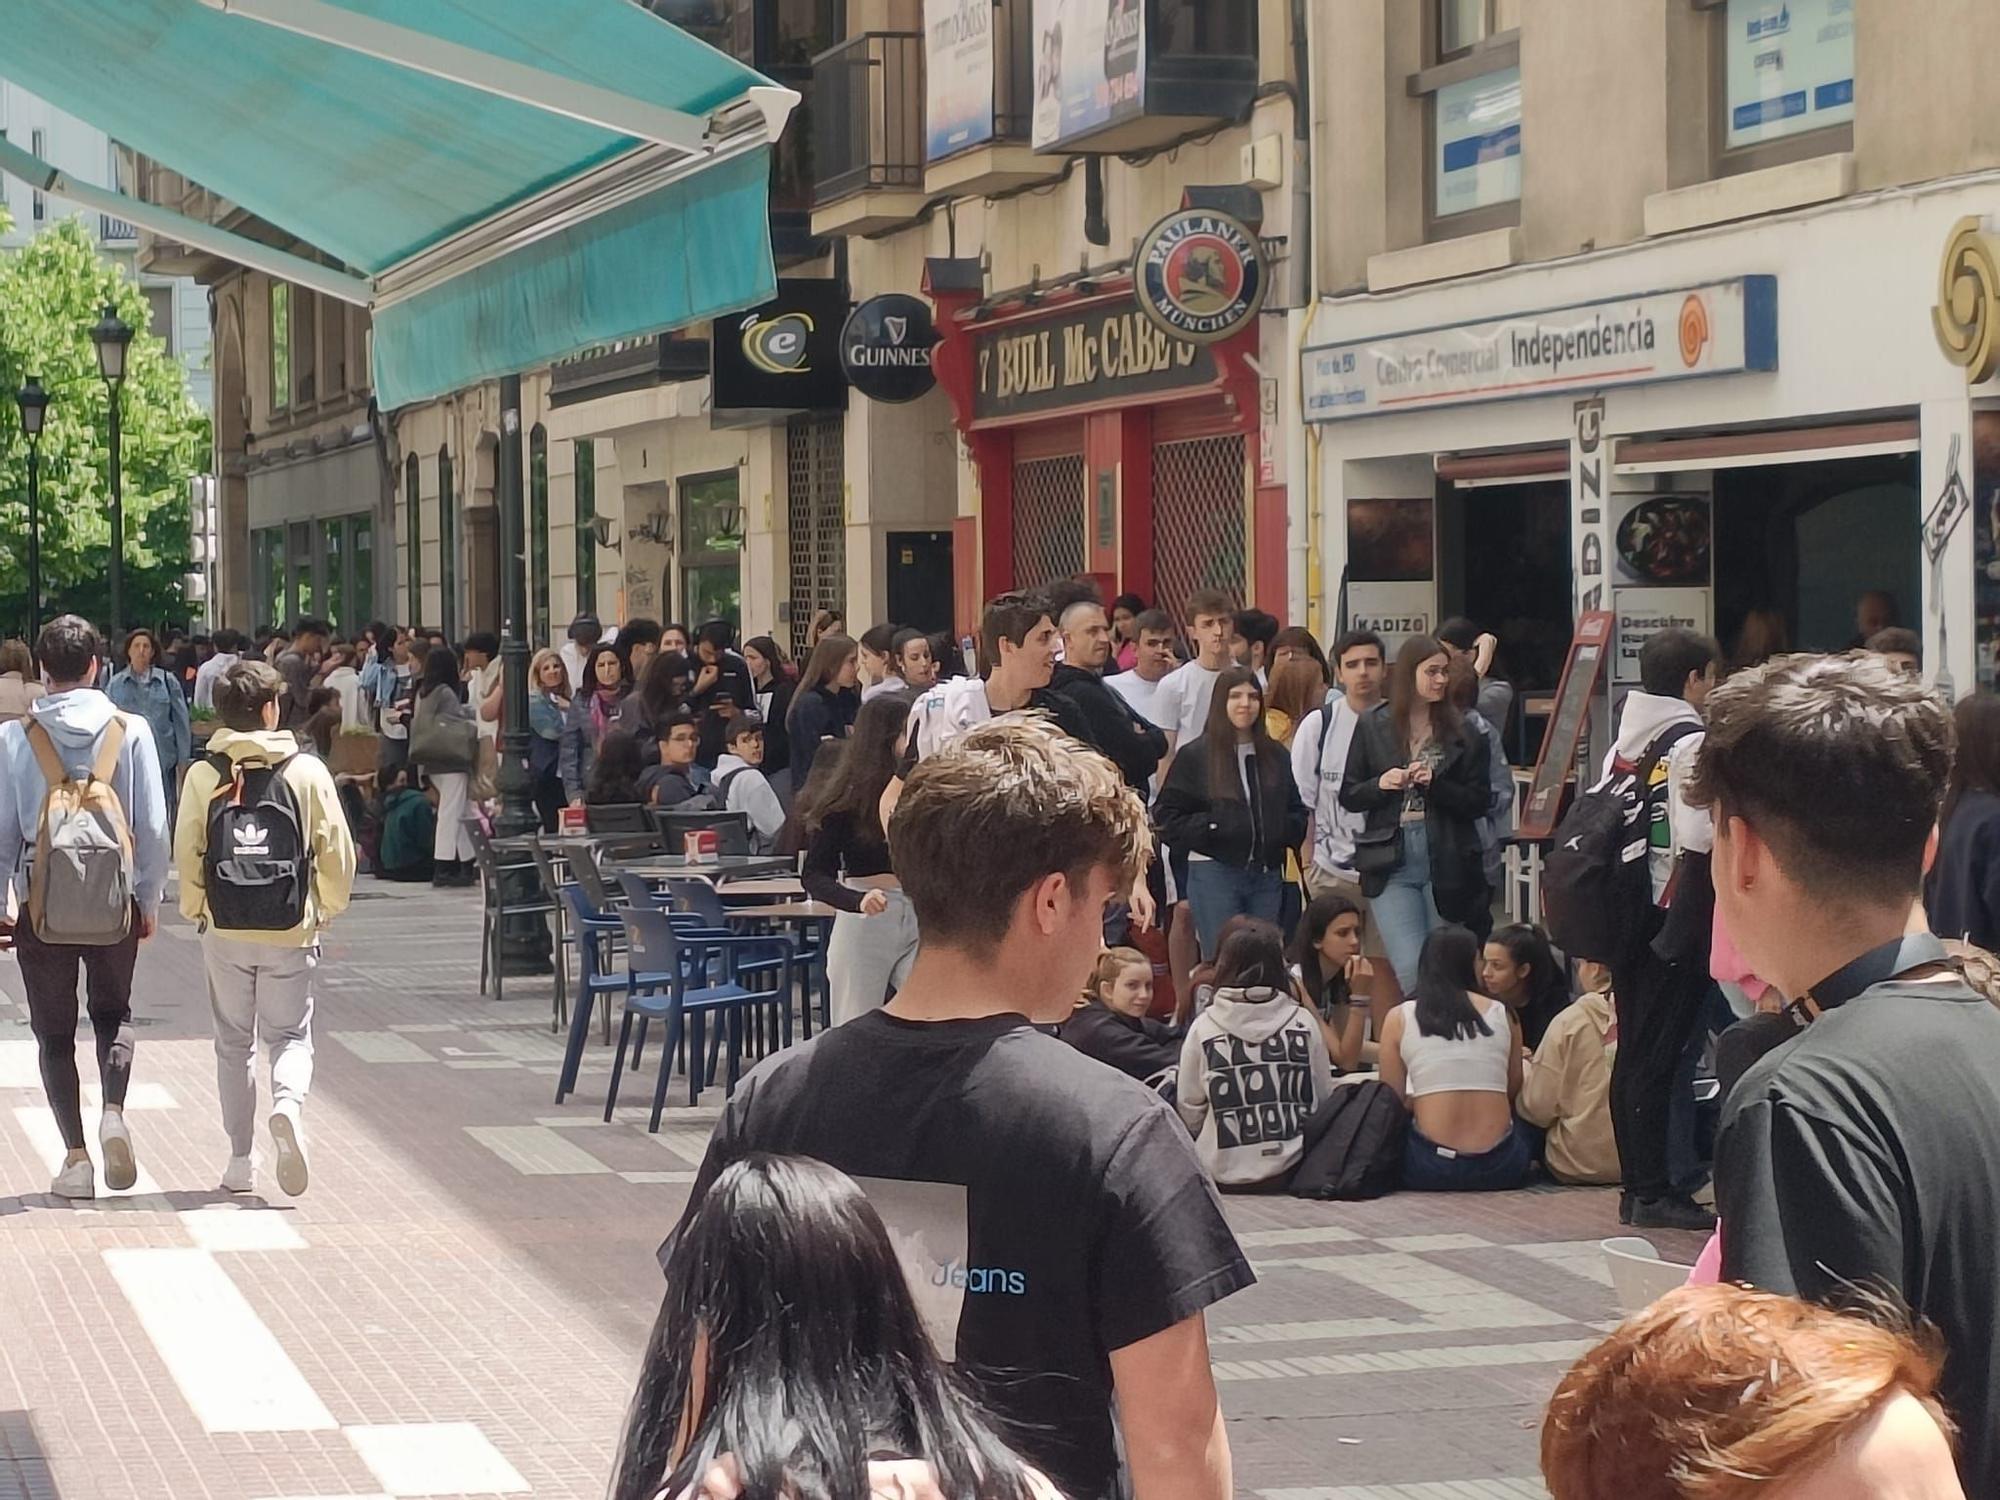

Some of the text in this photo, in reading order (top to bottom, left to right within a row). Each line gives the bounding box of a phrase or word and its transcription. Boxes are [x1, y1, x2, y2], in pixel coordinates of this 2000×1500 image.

[1148, 217, 1255, 266] PAULANER
[850, 344, 930, 367] GUINNES
[997, 331, 1056, 398] BULL
[1377, 353, 1423, 387] Centro
[1427, 338, 1500, 378] Comercial
[1511, 305, 1655, 374] Independencia
[931, 1258, 1026, 1295] Jeans
